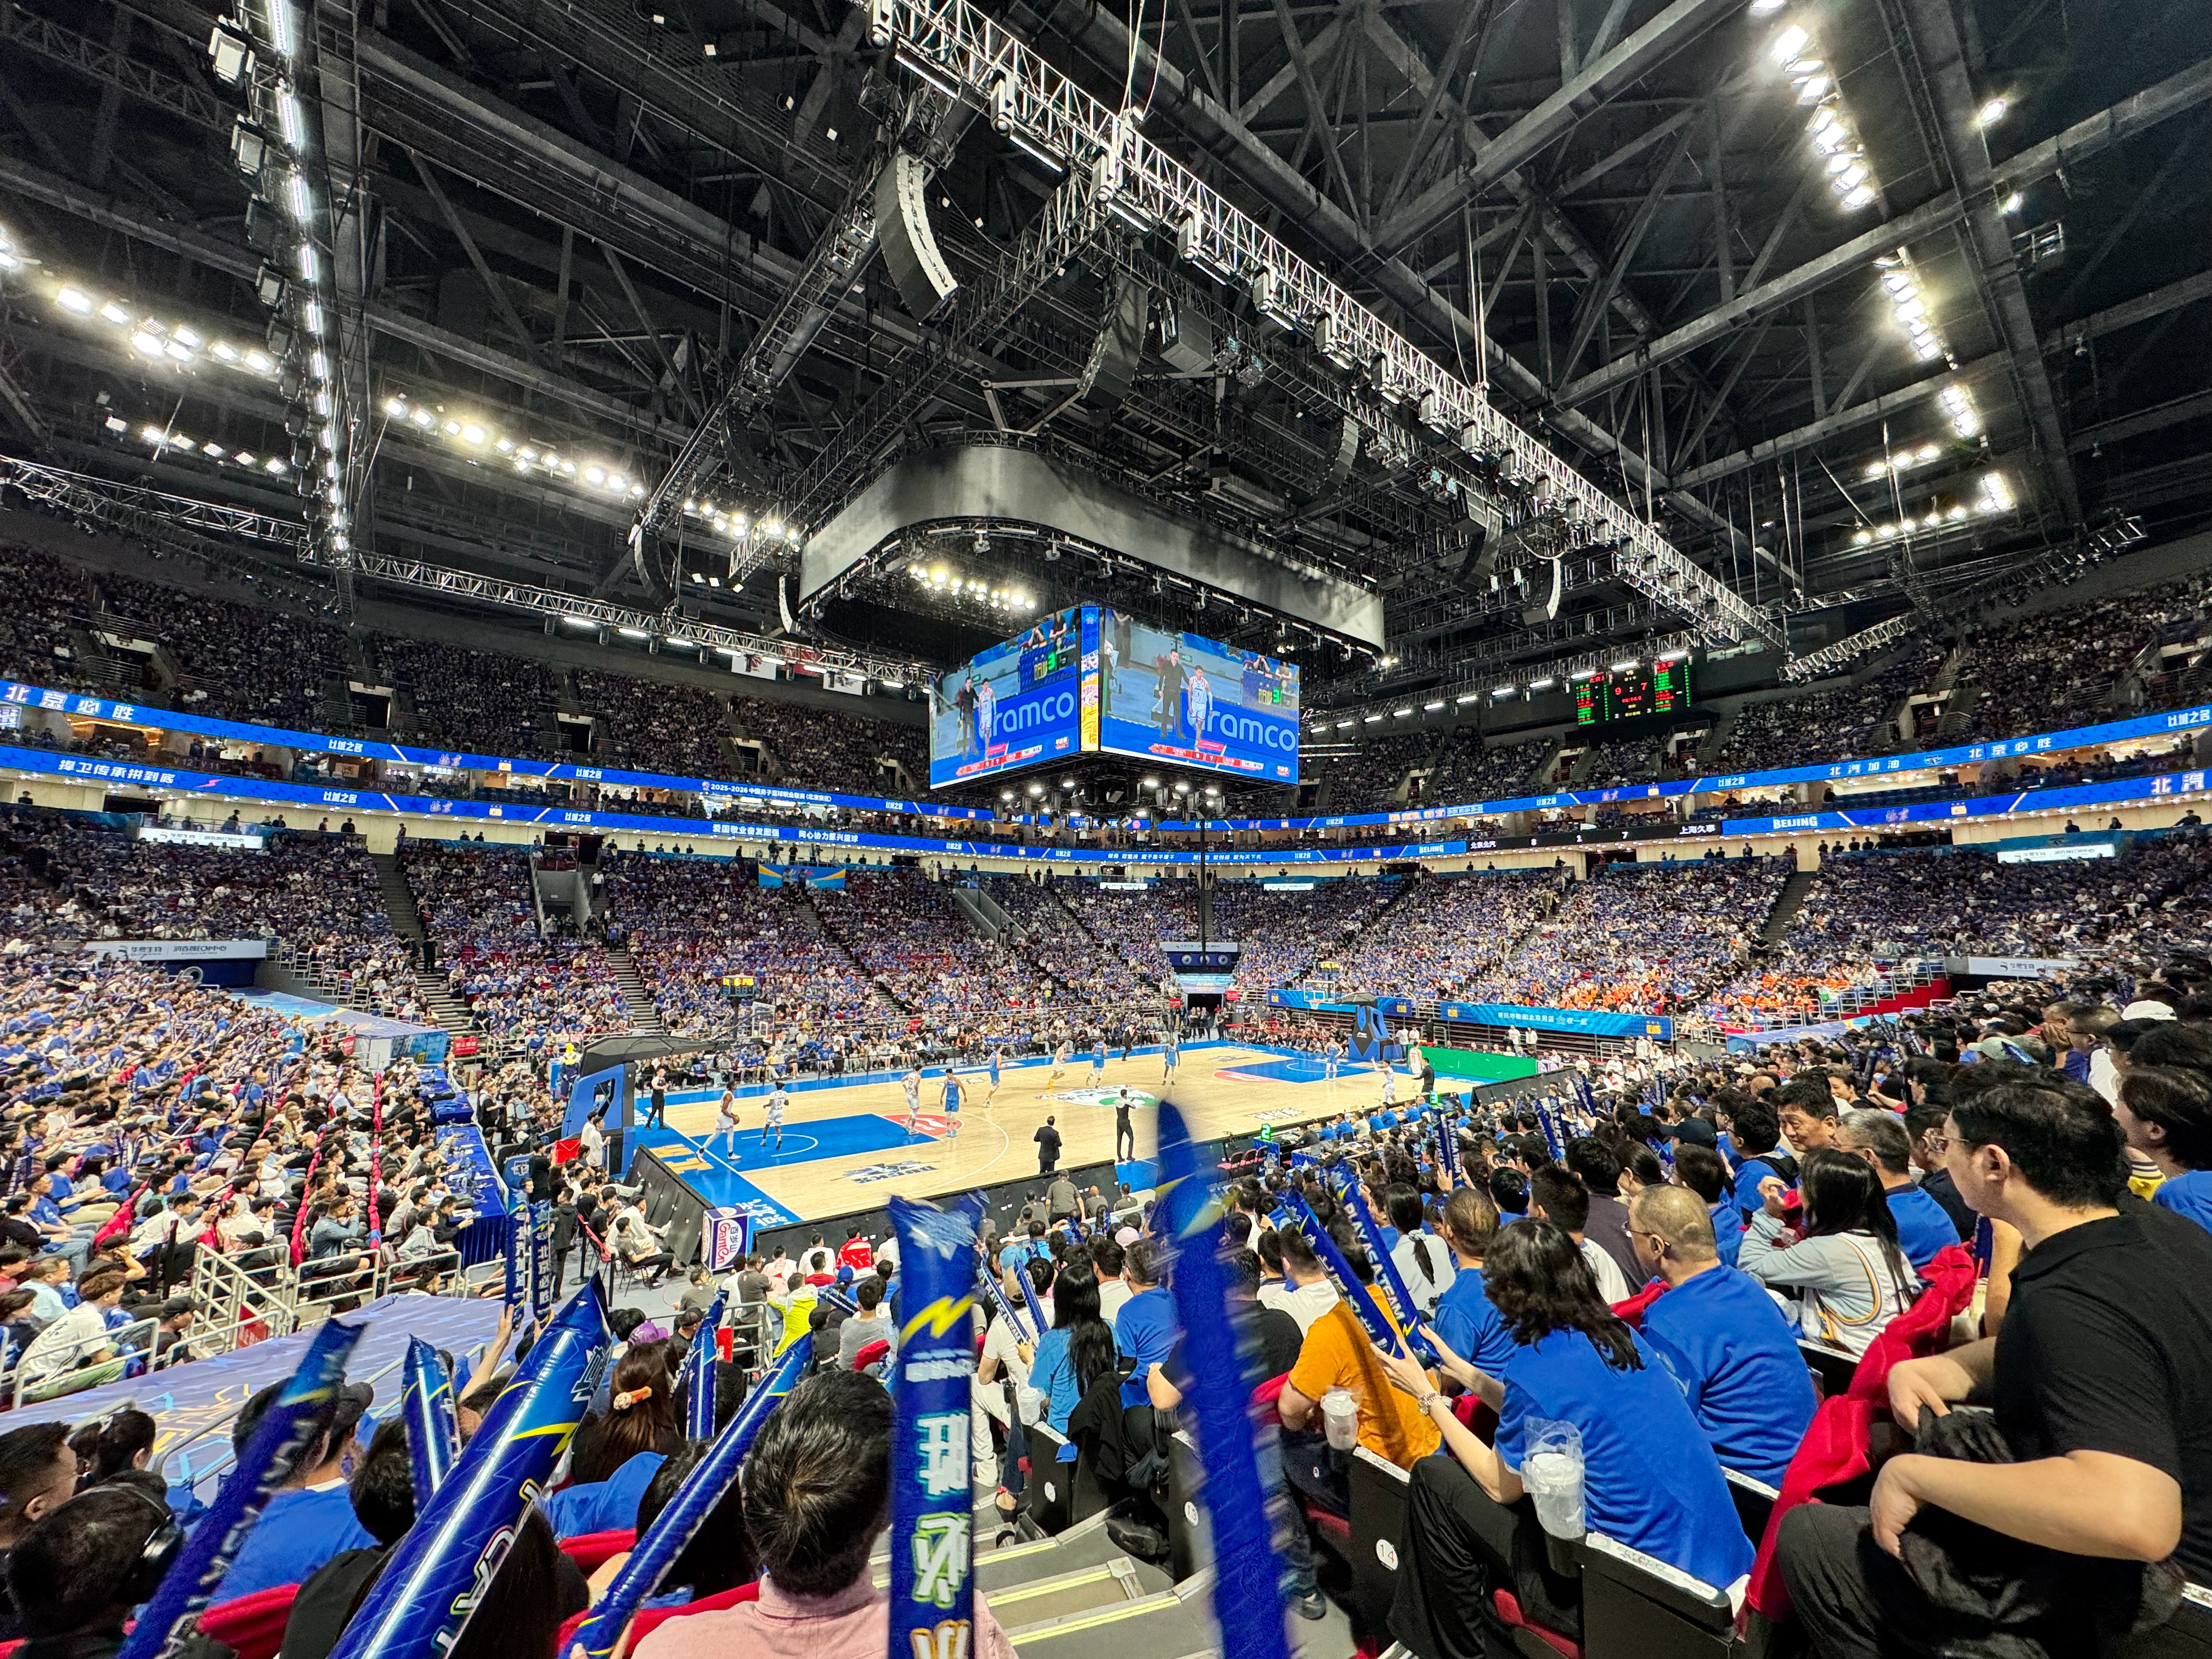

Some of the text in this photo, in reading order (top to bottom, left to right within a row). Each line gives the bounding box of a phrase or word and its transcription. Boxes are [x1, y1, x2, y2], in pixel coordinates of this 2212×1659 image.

[1615, 687, 1622, 695] 9
[1641, 682, 1647, 690] 7
[5, 686, 134, 720] 北京必胜
[2168, 709, 2210, 727] 以城之名
[329, 739, 363, 753] 以城之名
[1969, 737, 2051, 758] 北京必胜
[58, 759, 176, 784] 捍卫传承拼到底
[576, 768, 602, 779] 以城之名
[1829, 760, 1899, 775] 北汽加油
[1718, 777, 1745, 787] 以城之名
[2151, 772, 2204, 794] 北汽
[323, 791, 358, 804] 以城之名
[1537, 797, 1557, 806] 以城之名
[565, 812, 591, 822] 以城之名
[1773, 816, 1818, 830] BEIJING
[713, 824, 780, 837] 爱国敬业奋发图强
[1622, 831, 1629, 839] 7
[1679, 825, 1716, 836] 上海久事
[1470, 840, 1497, 849] 北京北汽
[1576, 834, 1583, 843] 1
[1419, 844, 1444, 854] BEIJING
[1261, 1124, 1271, 1139] 2
[730, 1226, 739, 1253] 百岁山
[1379, 1543, 1395, 1564] 14
